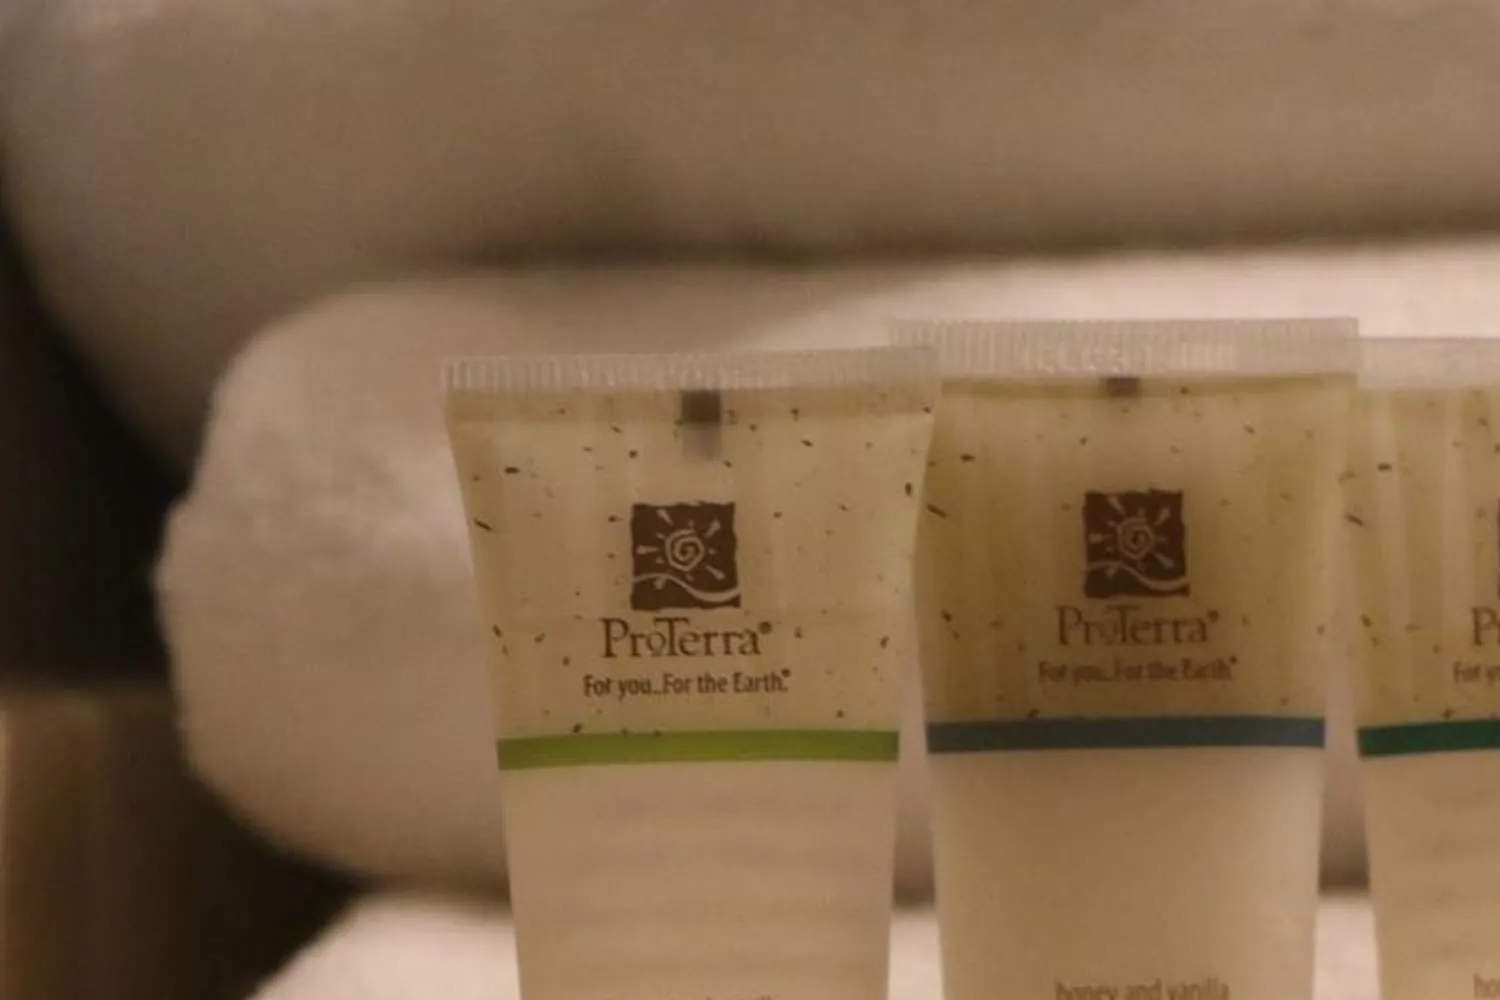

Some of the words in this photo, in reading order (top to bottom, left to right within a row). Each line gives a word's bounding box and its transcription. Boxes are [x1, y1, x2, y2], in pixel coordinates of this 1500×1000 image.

[600, 616, 771, 658] ProTerra
[583, 674, 612, 697] For
[697, 671, 728, 693] the
